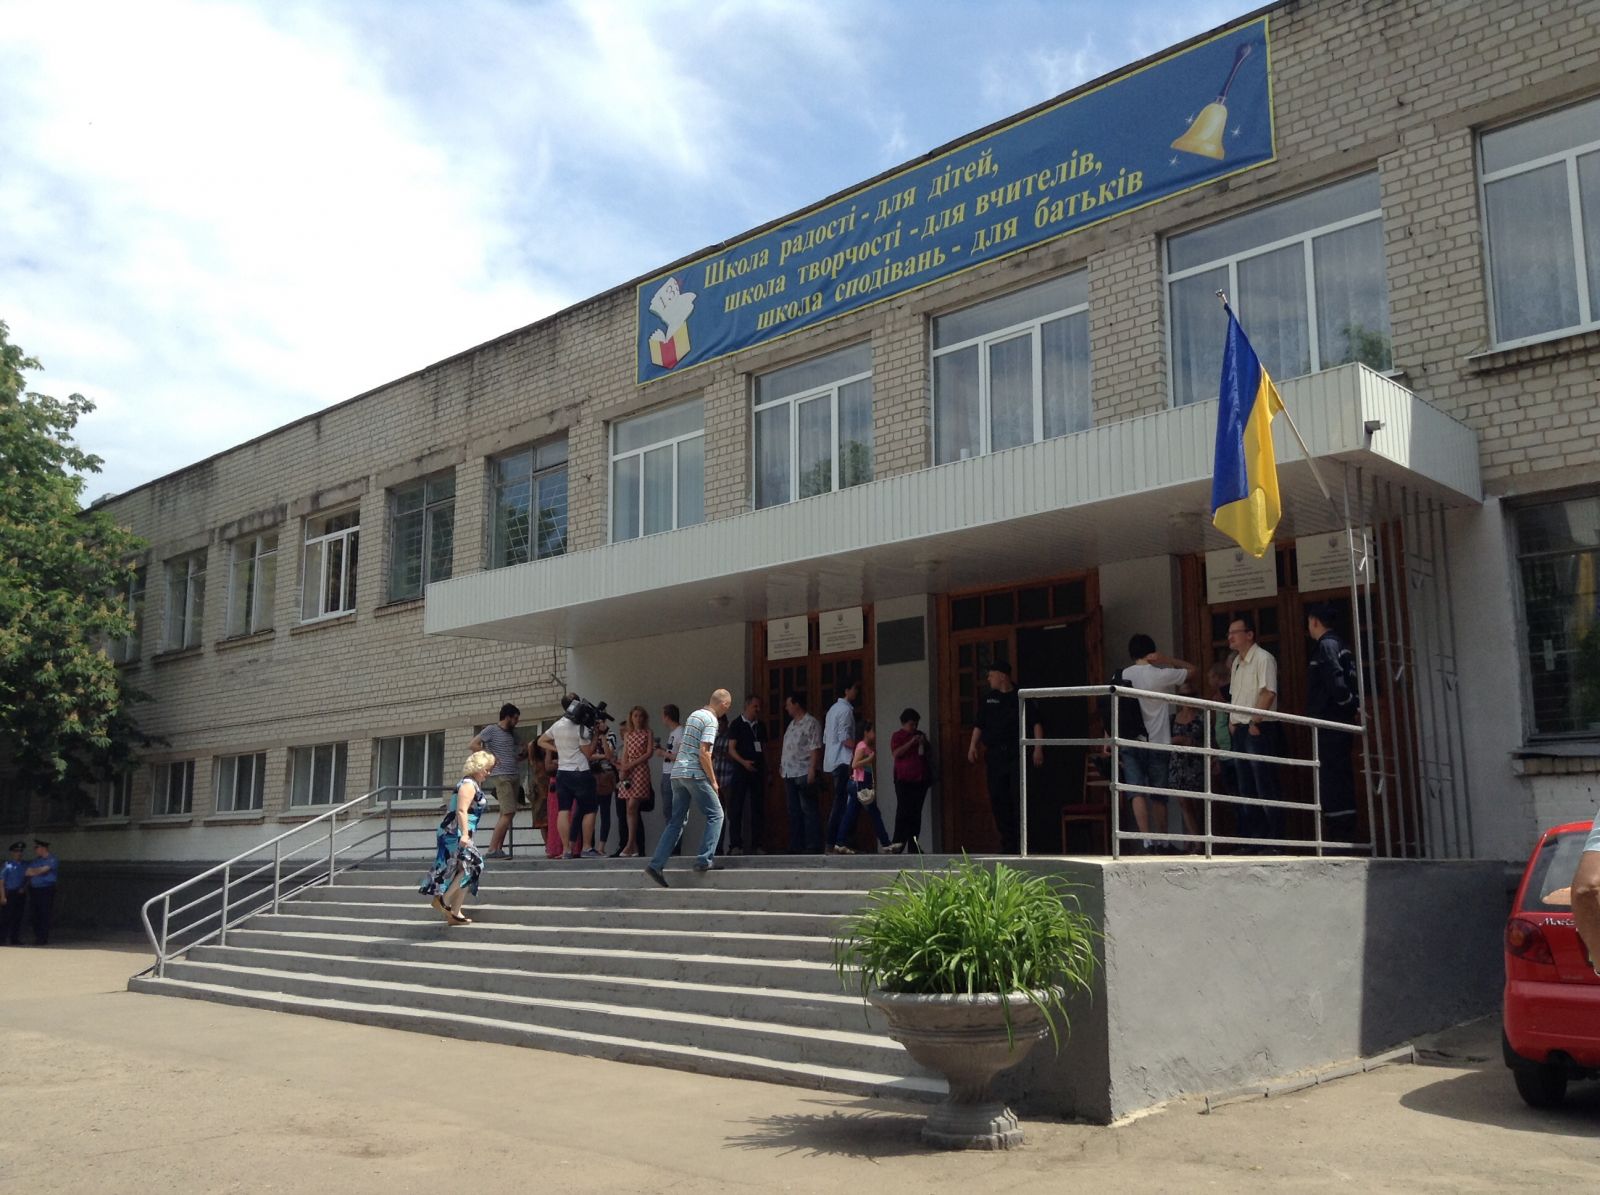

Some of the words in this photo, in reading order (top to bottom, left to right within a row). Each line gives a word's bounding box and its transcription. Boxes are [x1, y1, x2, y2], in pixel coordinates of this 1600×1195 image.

[704, 248, 769, 289] Школа
[779, 205, 857, 266] радості
[873, 186, 917, 224] для
[928, 147, 999, 202] дітей,
[724, 274, 786, 313] школа
[797, 220, 902, 285] творчості
[975, 149, 1102, 217] вчителів,
[757, 291, 823, 330] школа
[835, 246, 946, 303] сподівань
[970, 216, 1019, 256] для
[1034, 167, 1143, 229] батьків
